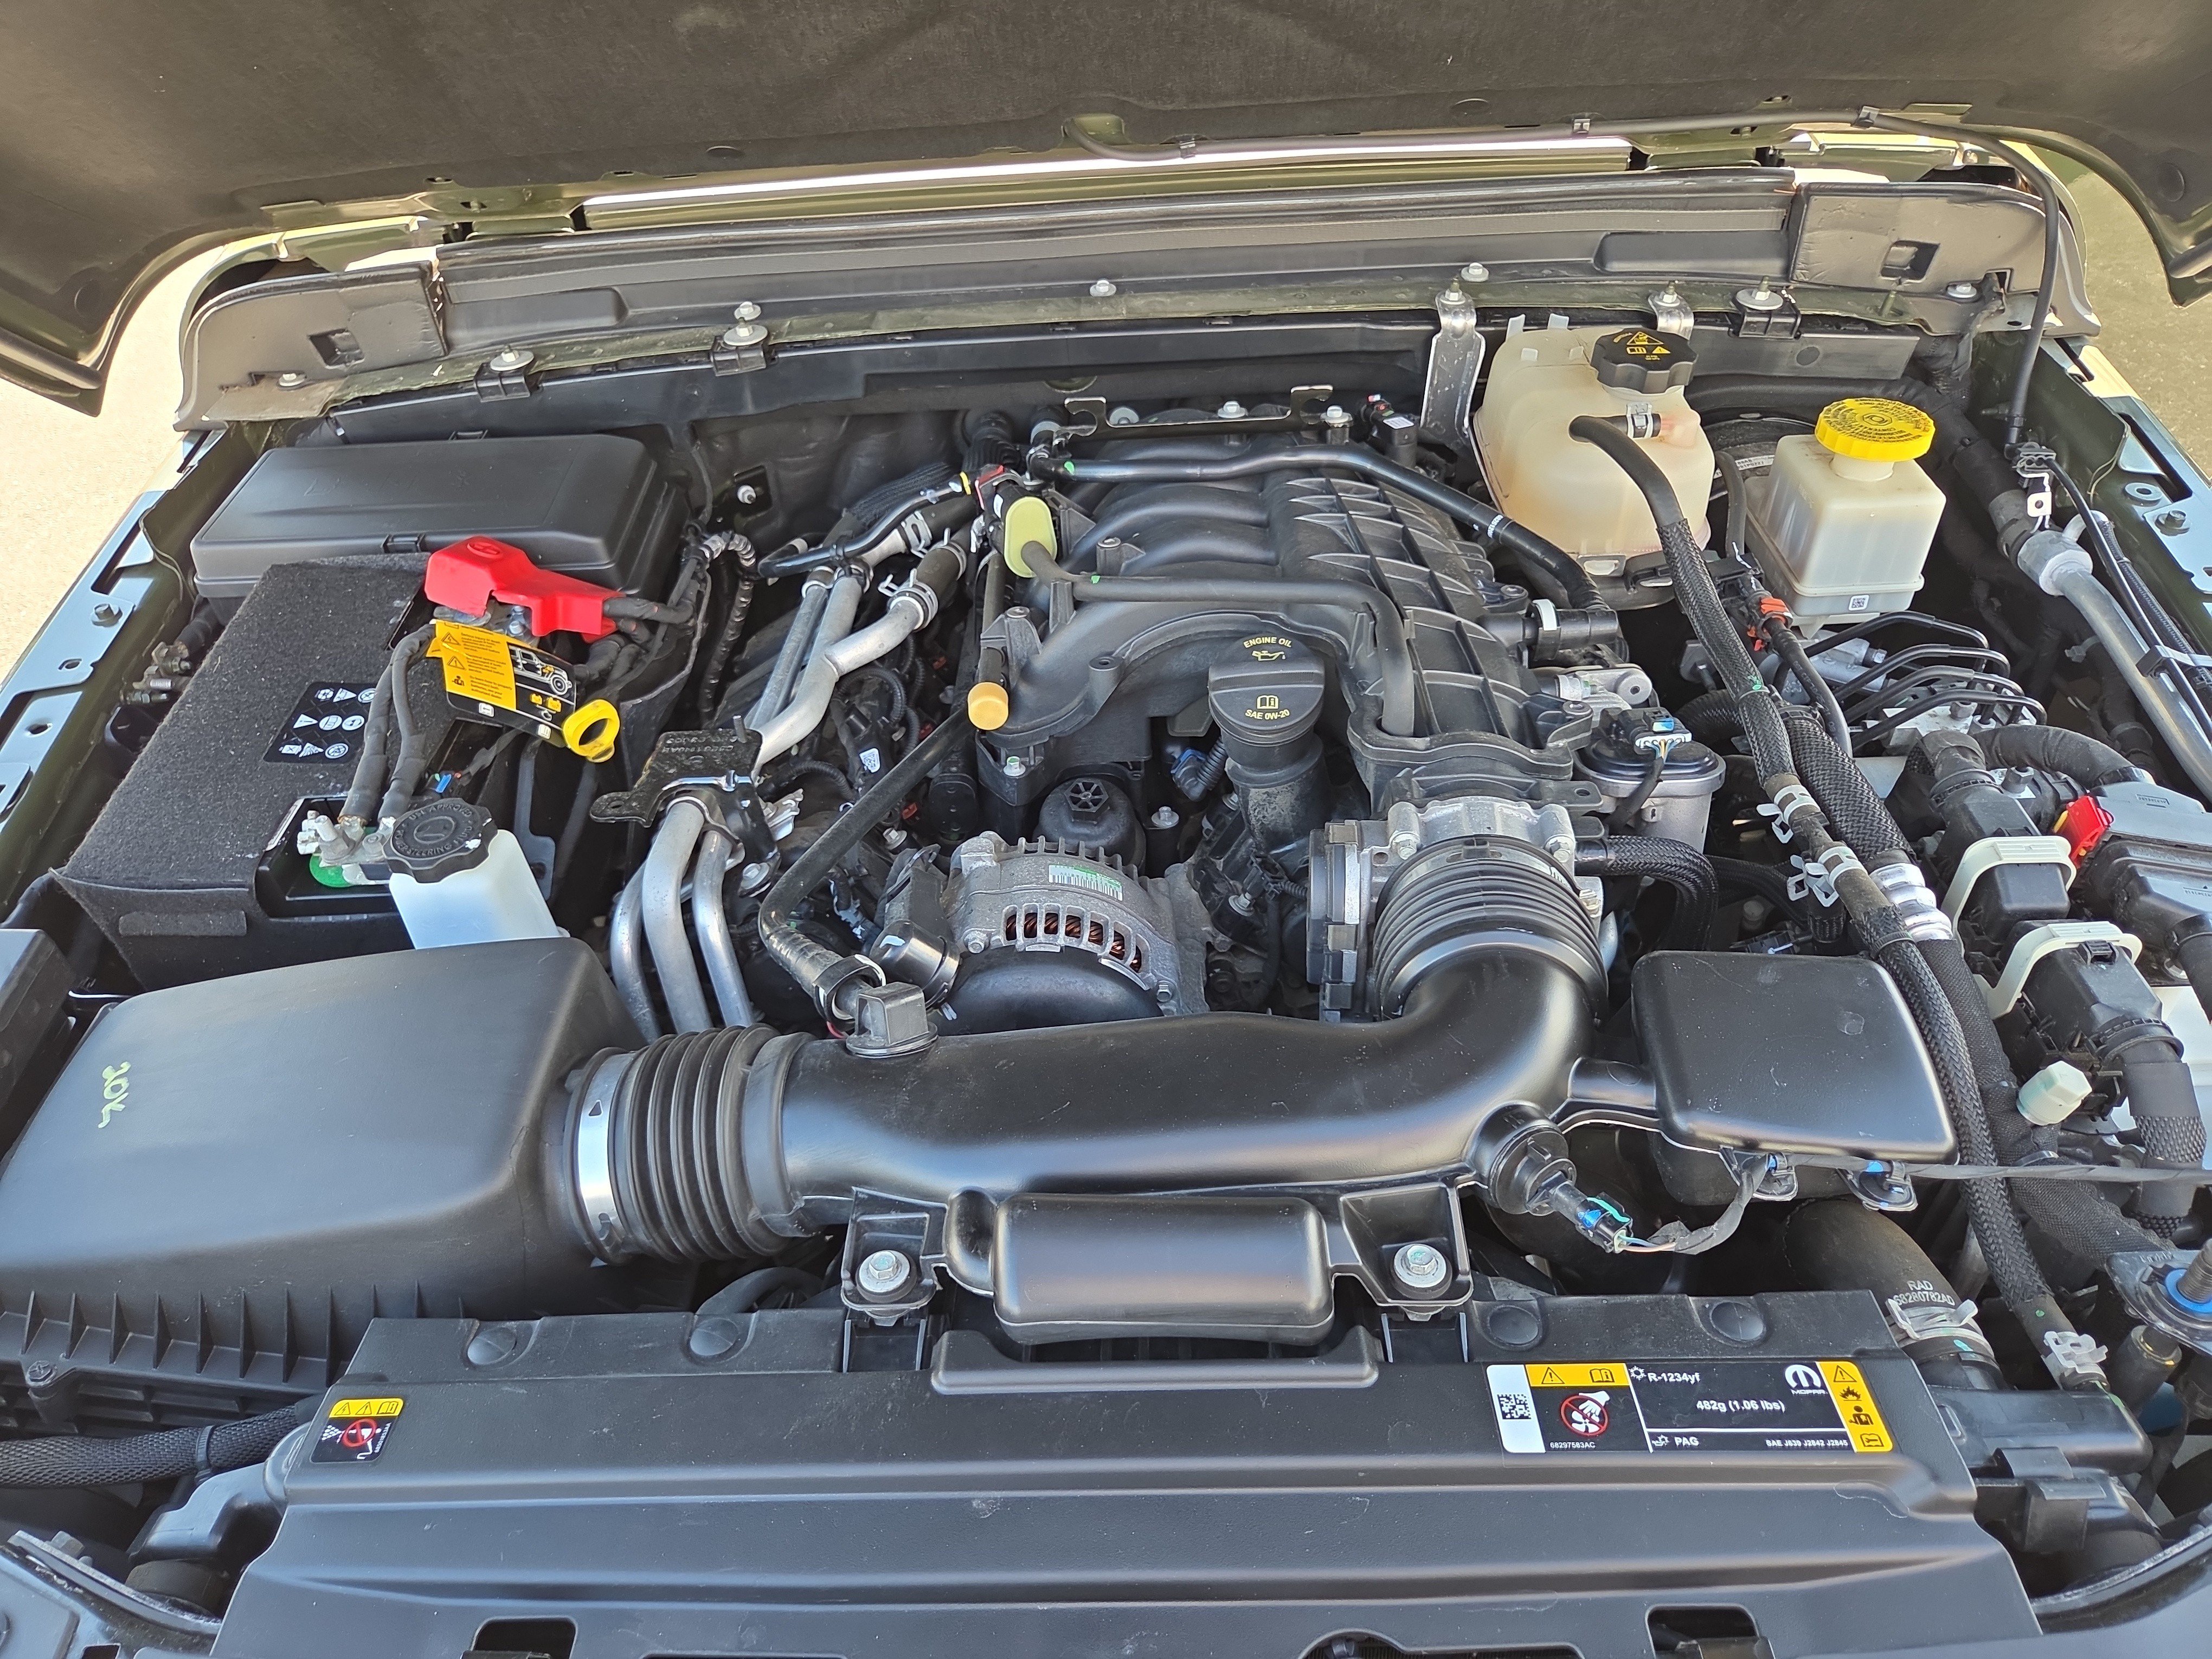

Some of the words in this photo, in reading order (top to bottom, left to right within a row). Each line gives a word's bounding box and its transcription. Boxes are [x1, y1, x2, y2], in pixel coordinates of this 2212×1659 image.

[1243, 636, 1277, 649] ENGINE
[1278, 637, 1293, 648] OIL
[1245, 709, 1263, 720] SAE
[1264, 709, 1290, 721] 0W-20
[429, 803, 473, 818] APPROVED
[1907, 1280, 1933, 1290] RAD
[1893, 1291, 1956, 1306] 68280782AD
[1647, 1372, 1701, 1384] R-1234yf
[1696, 1400, 1727, 1413] 482g
[1728, 1400, 1759, 1412] (1.06
[1760, 1400, 1786, 1413] lbs)
[1674, 1437, 1699, 1447] PAG
